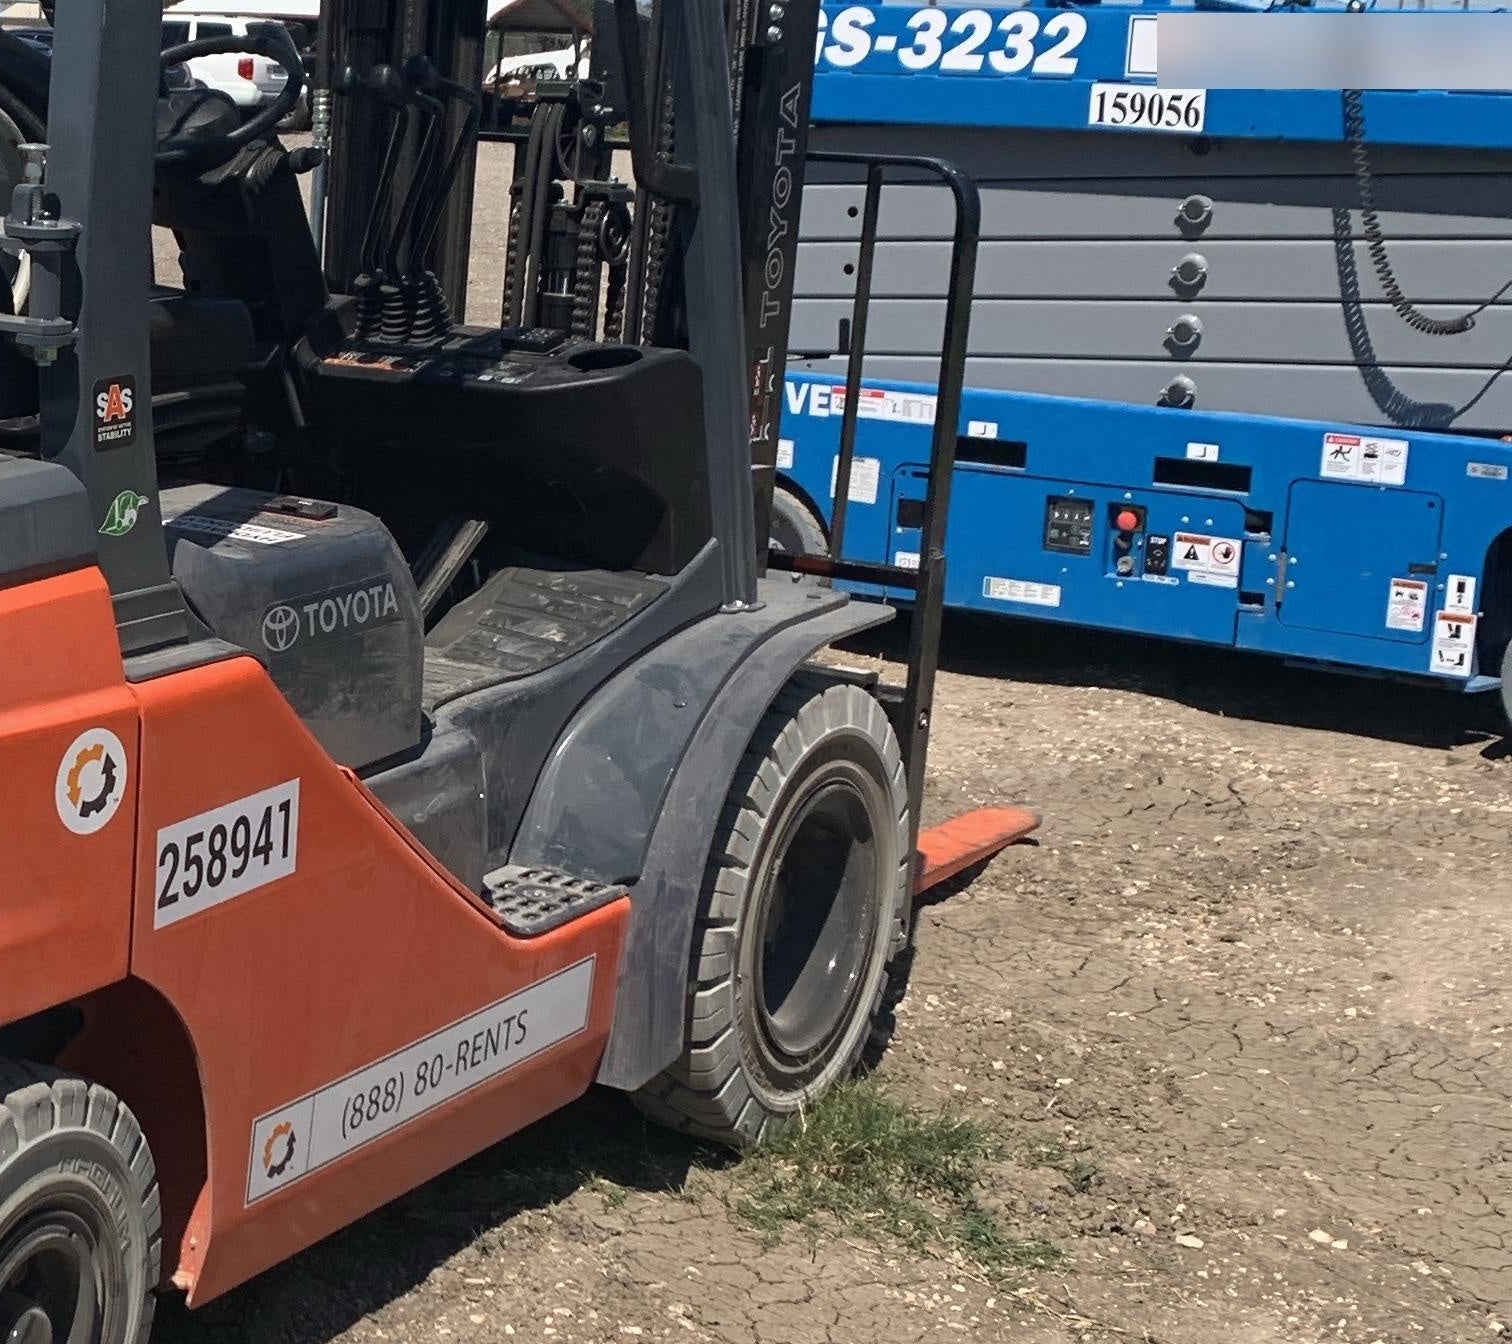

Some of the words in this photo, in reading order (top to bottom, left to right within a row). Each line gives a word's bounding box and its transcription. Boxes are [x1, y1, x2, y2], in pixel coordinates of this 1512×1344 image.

[1094, 90, 1203, 129] 159056
[759, 80, 802, 330] TOYOTA
[96, 383, 133, 423] SAS
[97, 426, 132, 443] STABILITY
[303, 582, 399, 637] TOYOTA
[157, 798, 291, 910] 258941
[341, 1071, 405, 1140] (888)
[414, 1008, 528, 1096] 80-RENTS
